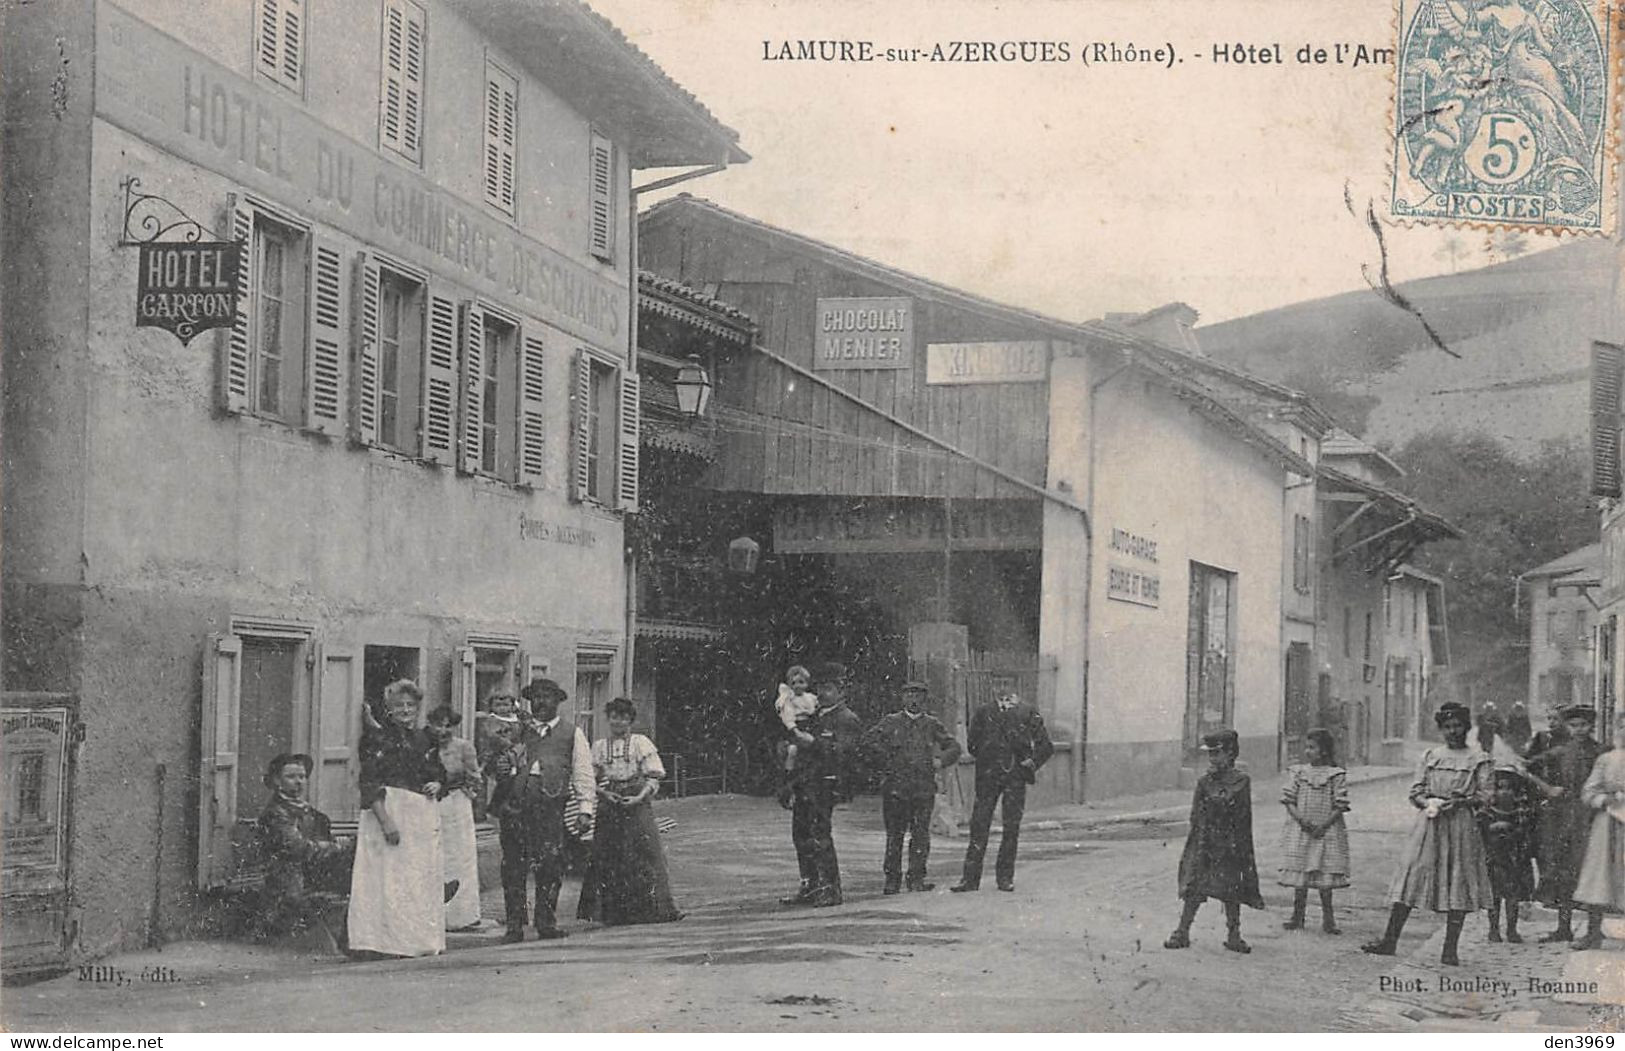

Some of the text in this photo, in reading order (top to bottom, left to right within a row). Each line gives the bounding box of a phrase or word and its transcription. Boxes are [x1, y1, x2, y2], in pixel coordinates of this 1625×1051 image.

[183, 65, 293, 181] HOTEL
[316, 138, 353, 208] DU
[373, 172, 498, 282] COMMERCE
[1452, 194, 1542, 219] POSTES
[147, 250, 229, 288] HOTEL
[822, 309, 908, 333] CHOCOLAT
[822, 337, 901, 362] MENIER
